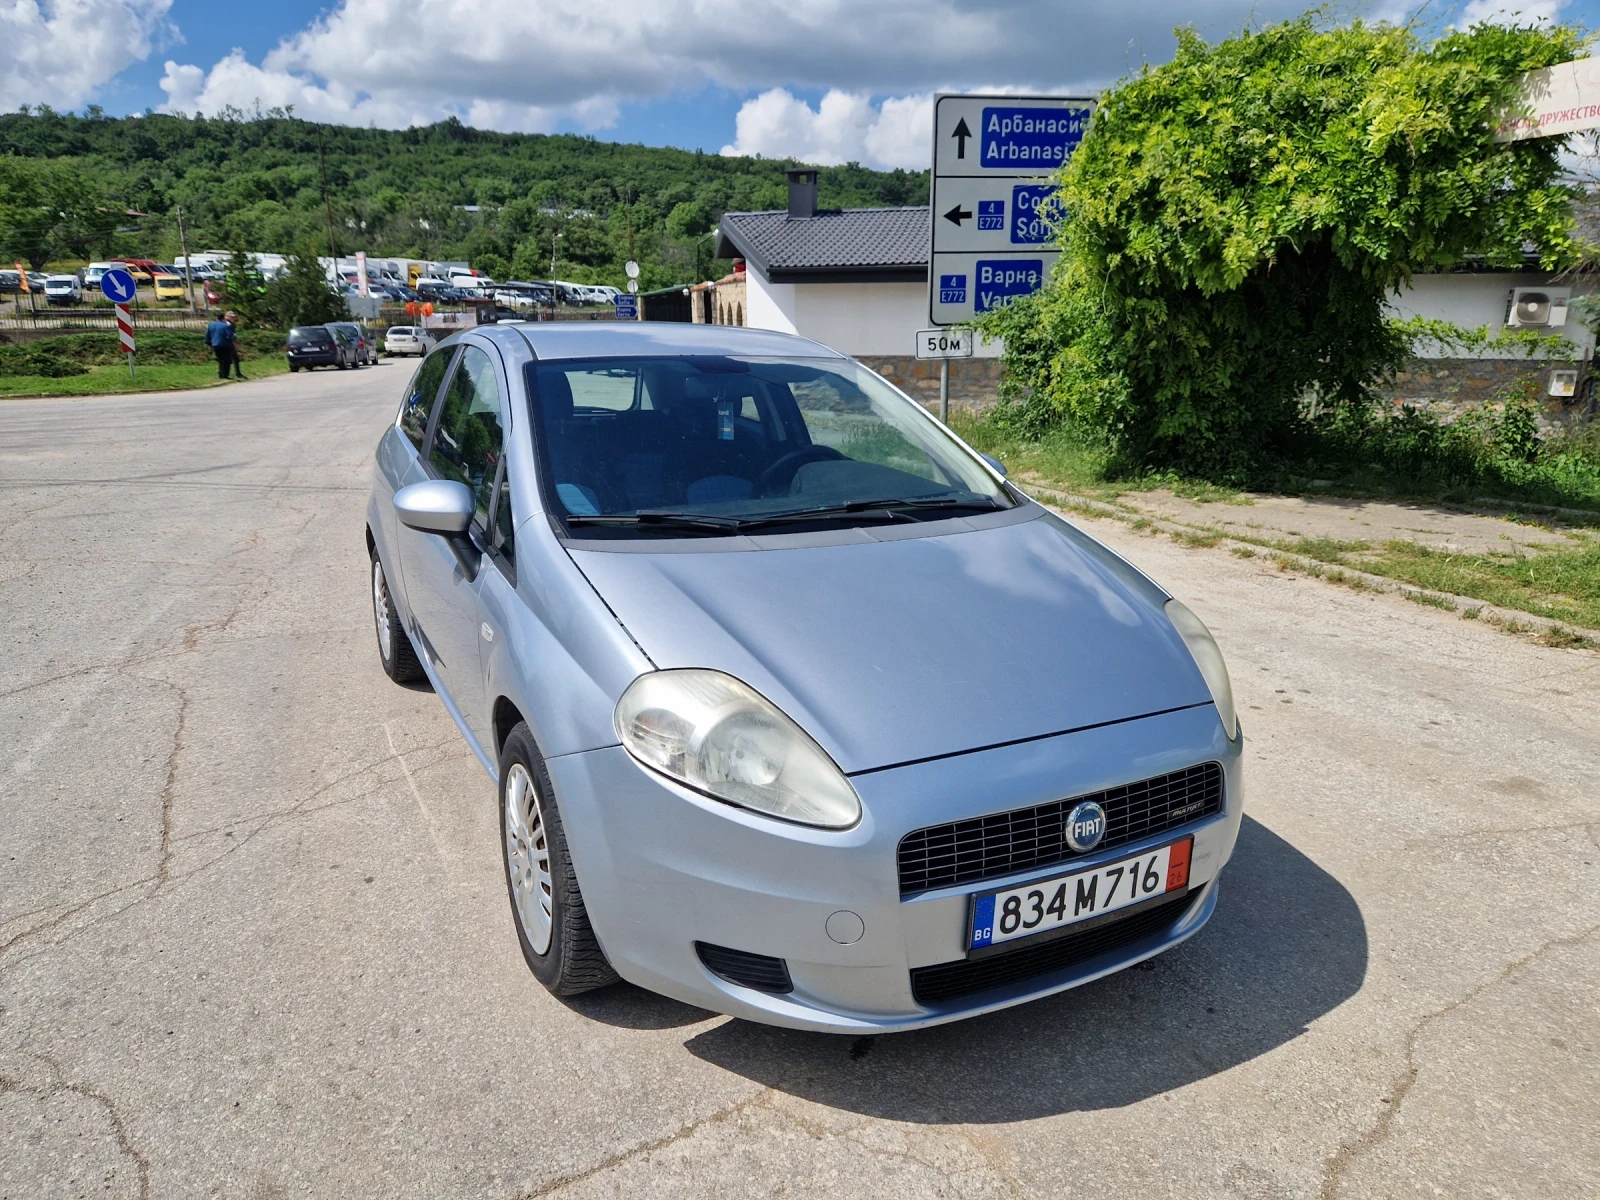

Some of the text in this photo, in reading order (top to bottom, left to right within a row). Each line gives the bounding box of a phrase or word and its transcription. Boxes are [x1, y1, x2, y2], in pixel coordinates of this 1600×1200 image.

[988, 114, 1079, 137] Арбанаси
[986, 141, 1068, 159] Arbanasi
[988, 202, 995, 213] 4
[979, 217, 1003, 229] E772
[950, 276, 957, 287] 4
[981, 266, 1037, 288] Варна
[941, 290, 965, 302] E772
[1074, 817, 1101, 838] FIAT
[974, 927, 991, 941] BG
